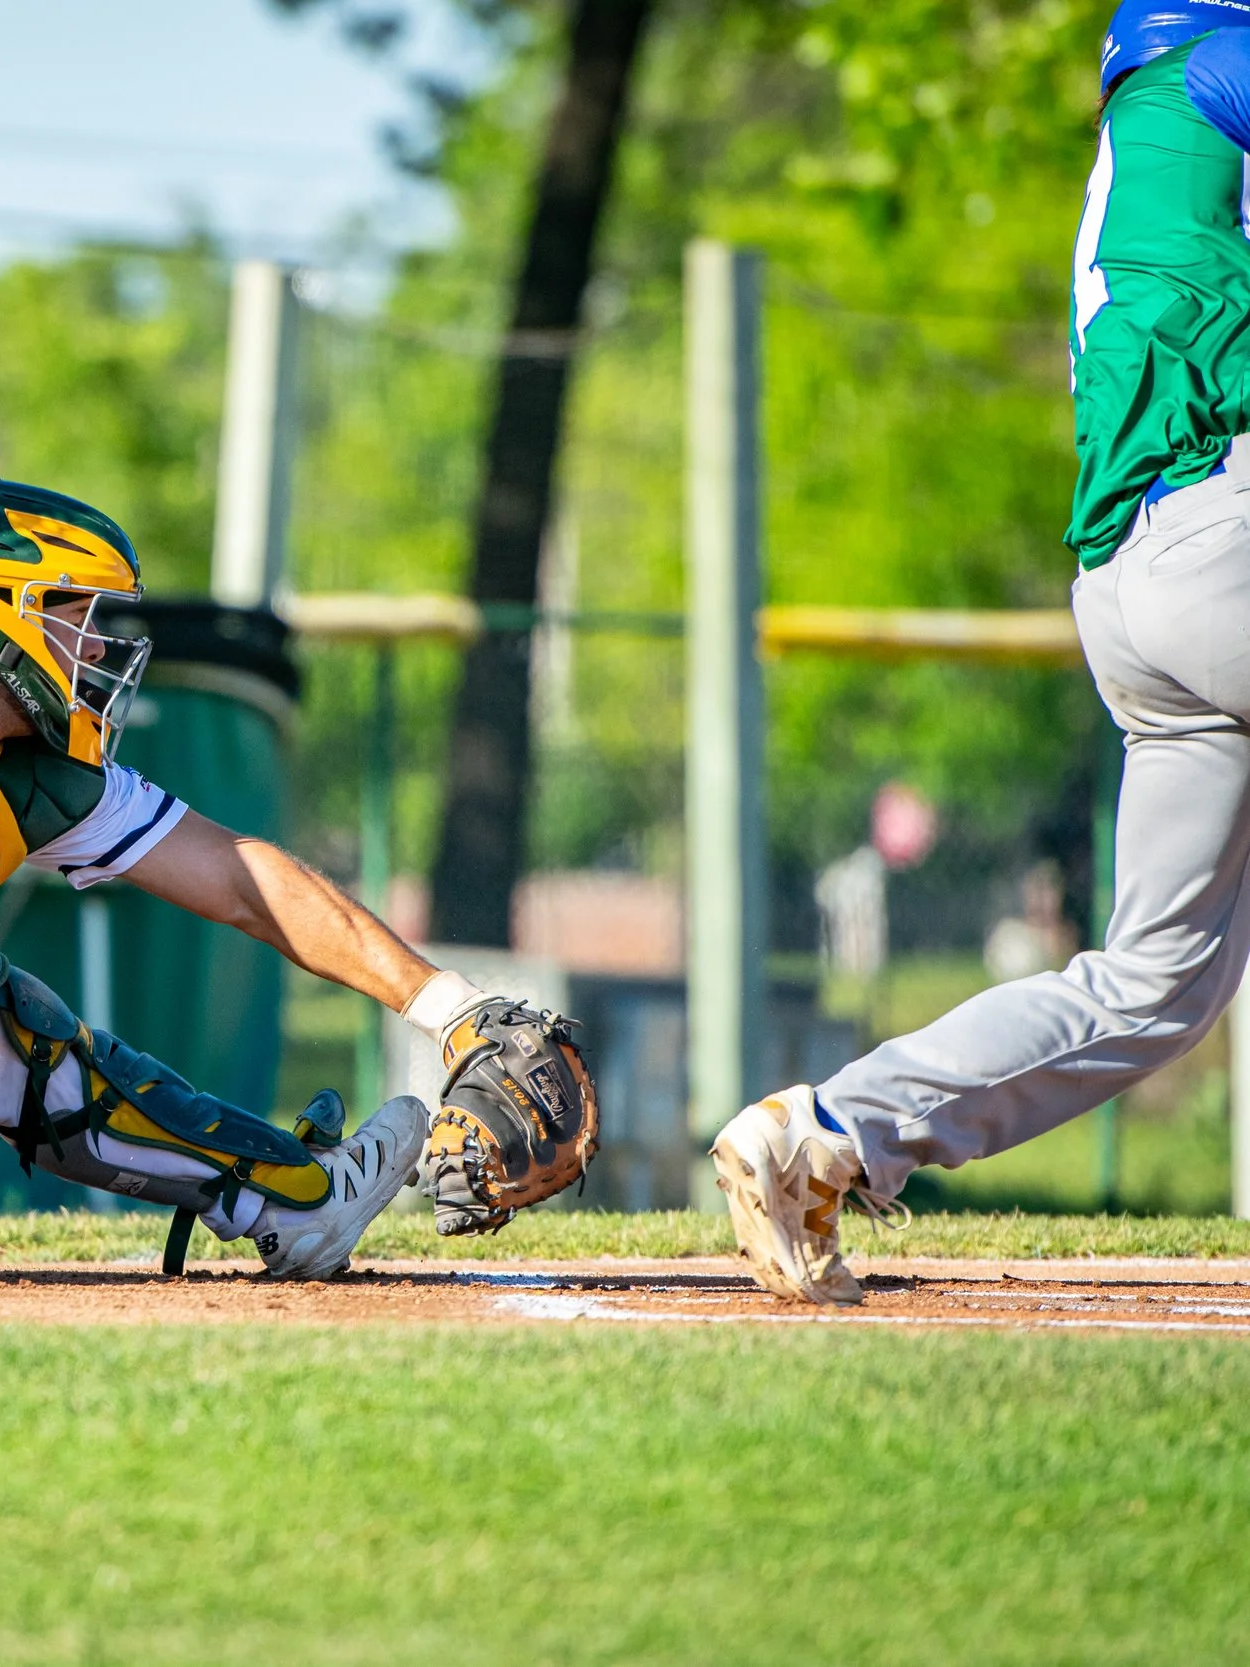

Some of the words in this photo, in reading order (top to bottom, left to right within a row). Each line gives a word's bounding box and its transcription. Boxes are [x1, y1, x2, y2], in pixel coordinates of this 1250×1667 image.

[2, 672, 40, 714] ALL-STAR
[502, 1078, 530, 1105] 20:15
[535, 1071, 564, 1112] Rawlings
